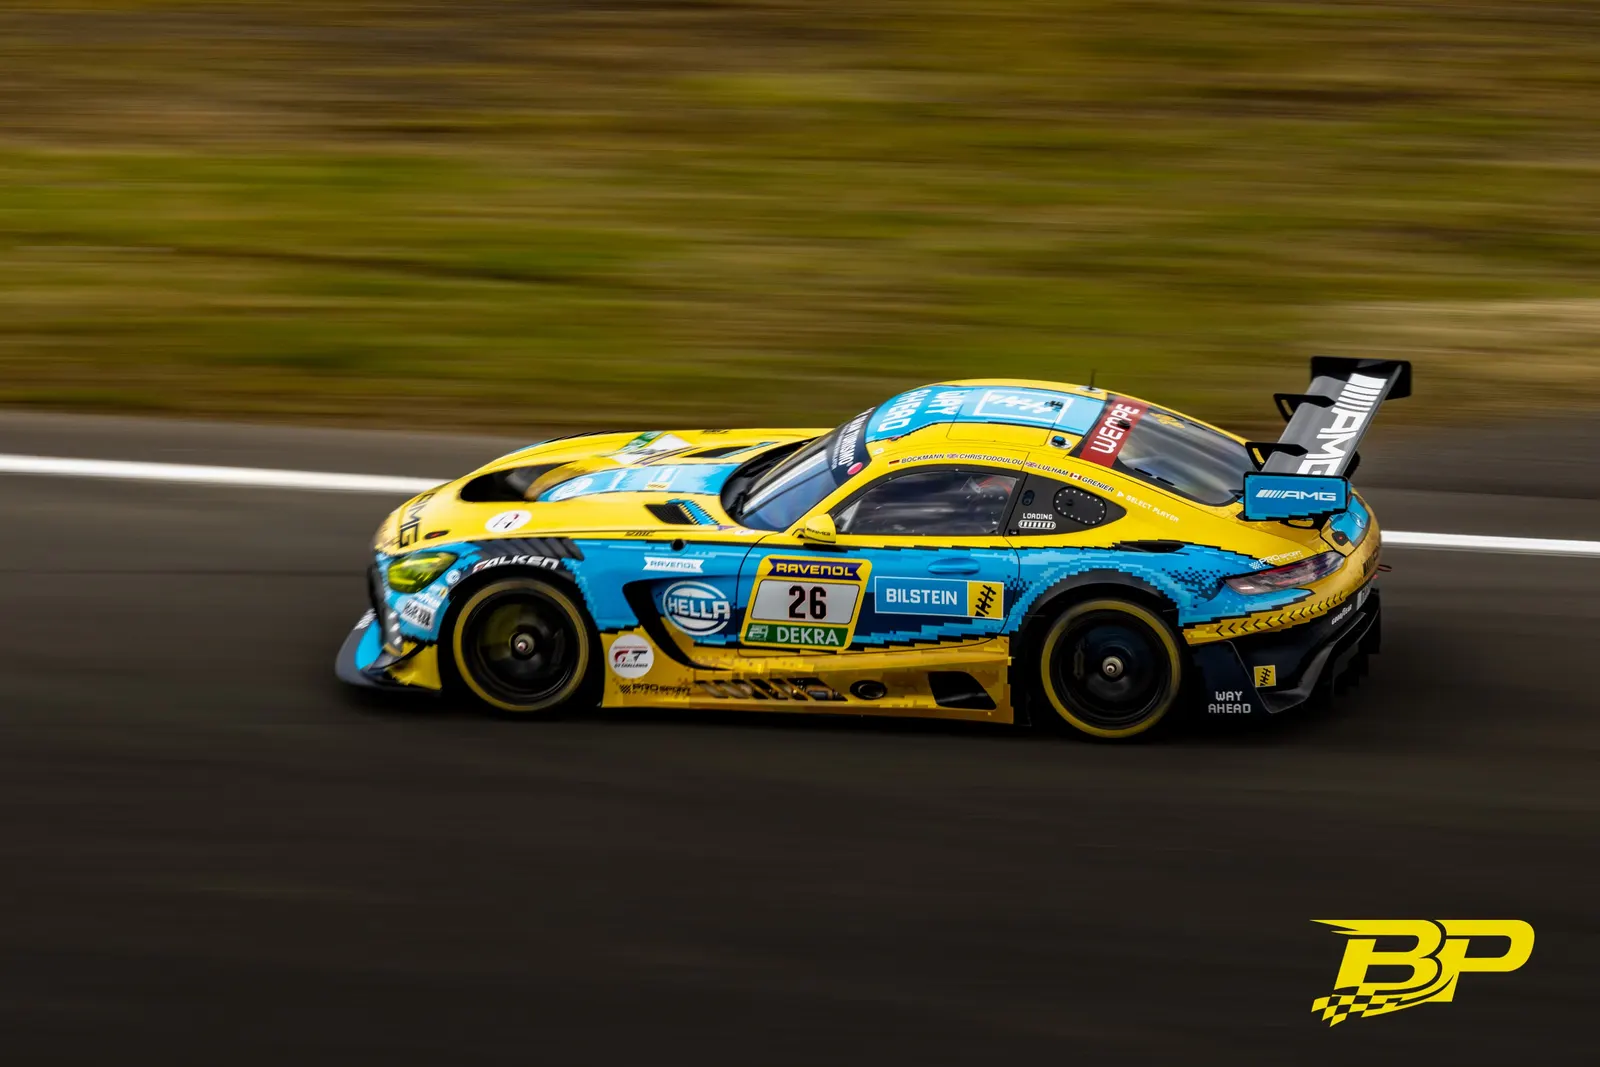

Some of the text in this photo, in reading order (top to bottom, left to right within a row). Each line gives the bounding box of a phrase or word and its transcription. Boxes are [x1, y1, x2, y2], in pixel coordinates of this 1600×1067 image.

[1090, 403, 1140, 454] WEMPE
[959, 453, 1024, 465] CHRISTODOULOU
[1037, 464, 1068, 476] LULHAM
[1081, 476, 1115, 493] GRENIER
[1125, 494, 1180, 522] SELECT PLAYER
[472, 555, 560, 573] FALKEN
[650, 561, 697, 569] RAVENOL
[775, 563, 854, 577] RAVENOL
[788, 585, 827, 620] 26
[885, 588, 958, 606] BILSTEIN
[667, 597, 731, 620] HELLA
[776, 626, 840, 646] DEKRA
[1215, 691, 1243, 701] WAY
[1208, 703, 1251, 714] AHEAD
